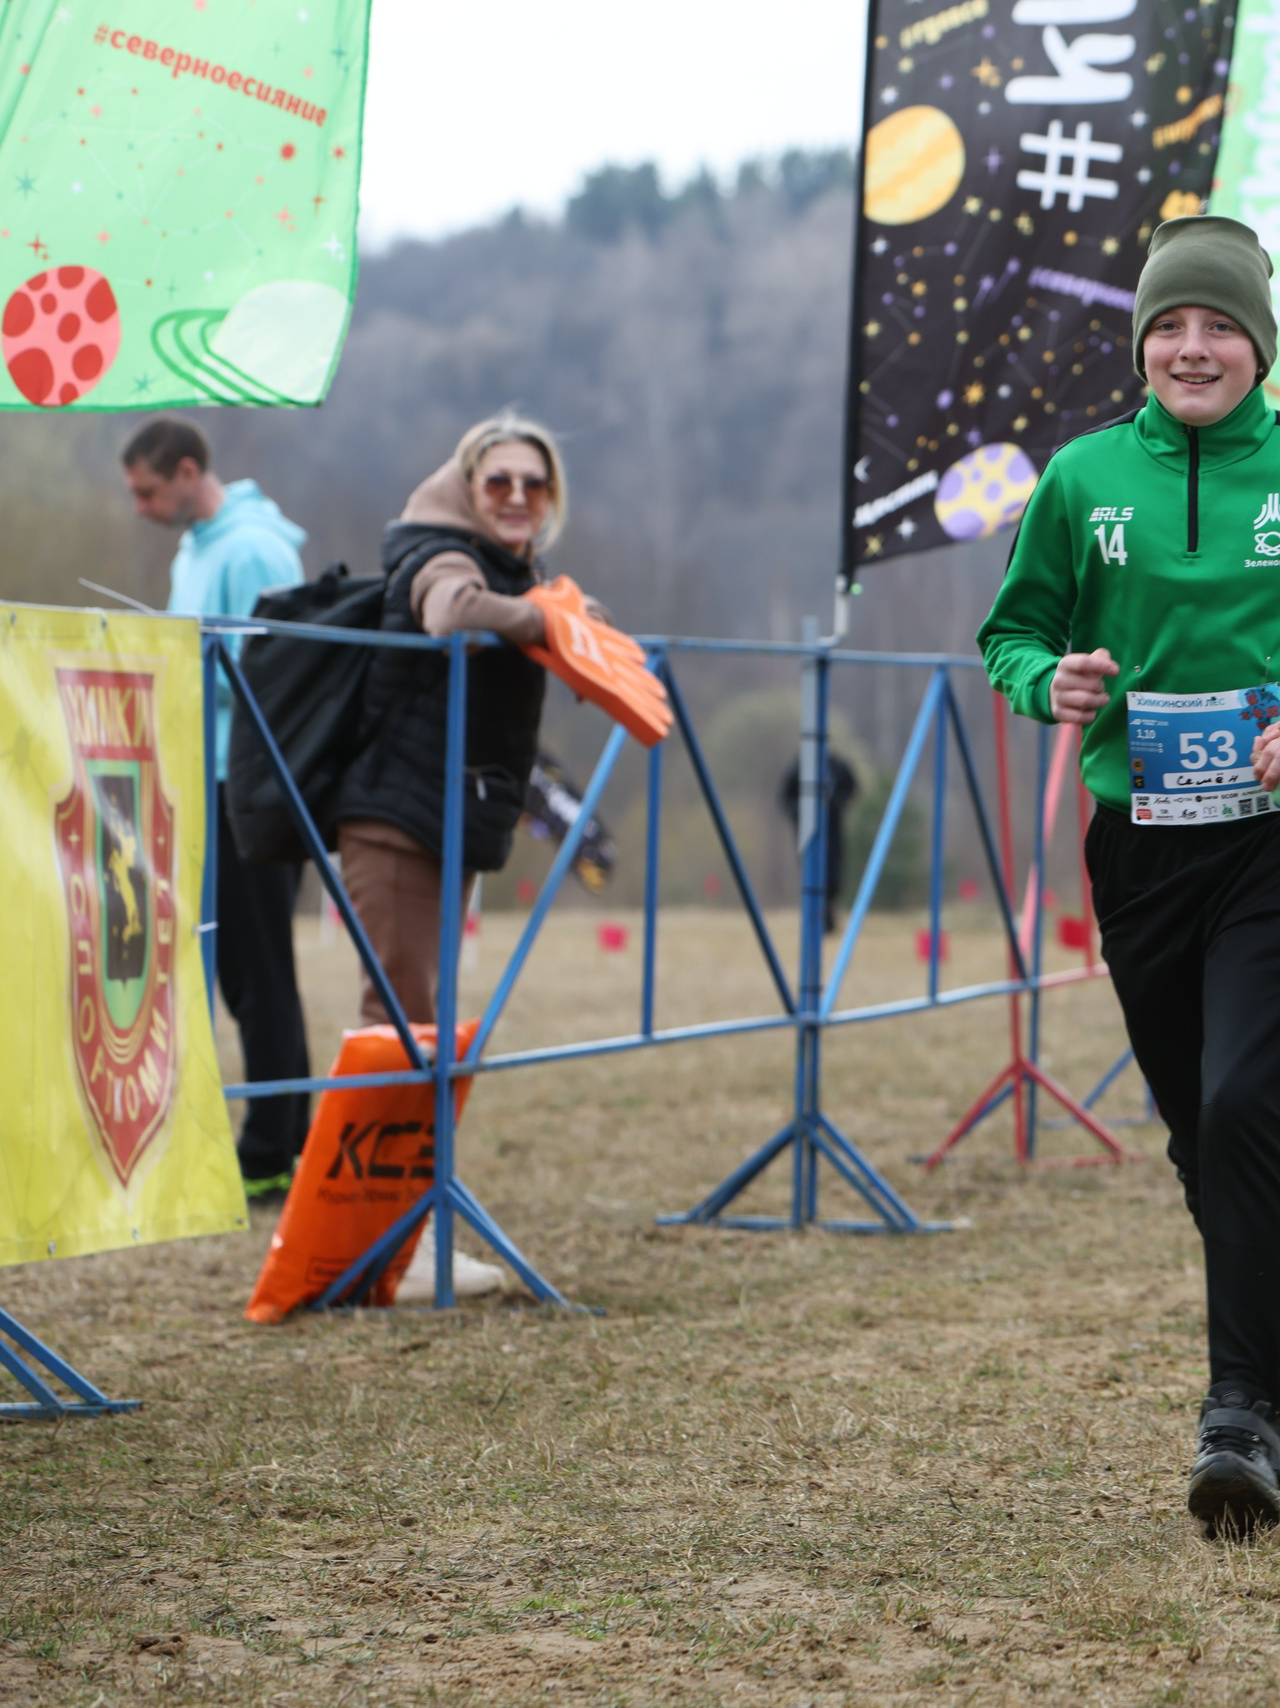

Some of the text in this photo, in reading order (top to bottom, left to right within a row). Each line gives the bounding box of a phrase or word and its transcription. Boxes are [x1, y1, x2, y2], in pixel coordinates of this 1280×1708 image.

[94, 23, 328, 127] #северноесияние
[1094, 524, 1128, 566] 14
[63, 683, 152, 748] ХИМКИ
[1179, 730, 1238, 770] 53
